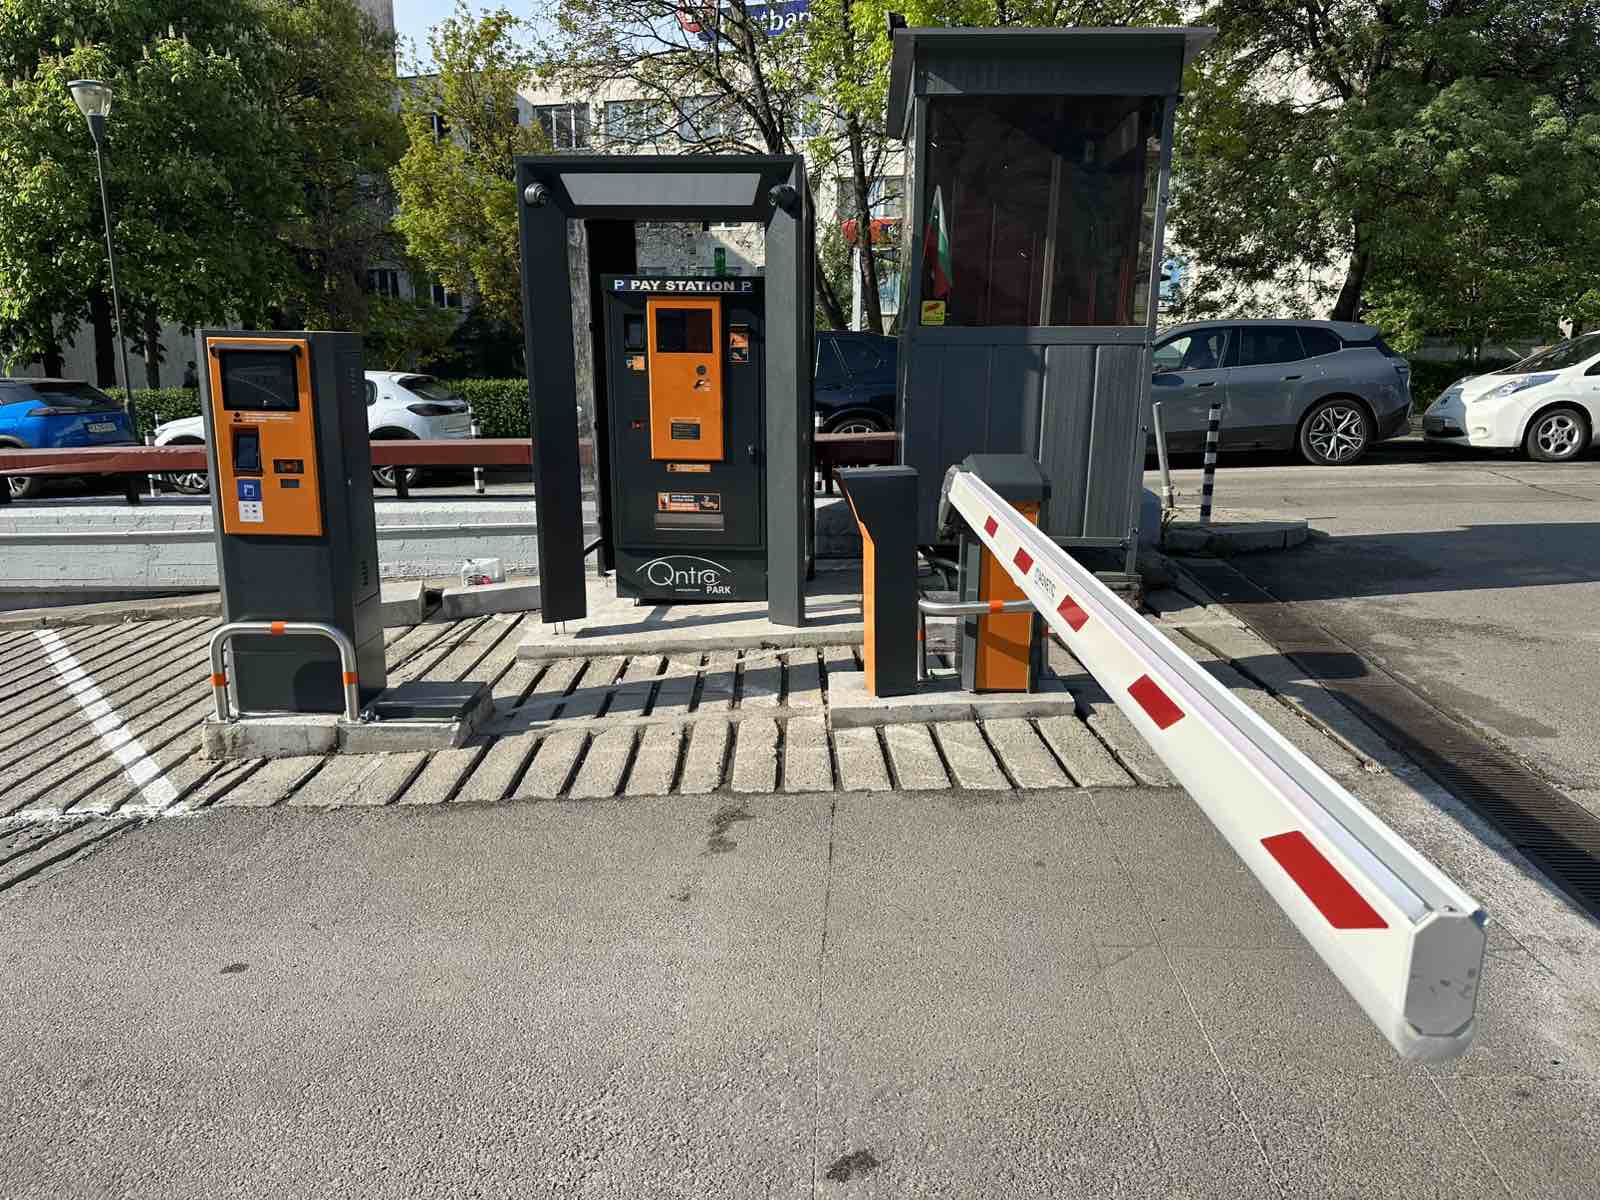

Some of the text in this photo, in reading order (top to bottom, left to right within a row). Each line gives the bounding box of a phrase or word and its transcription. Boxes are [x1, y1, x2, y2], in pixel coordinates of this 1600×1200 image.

[613, 279, 625, 290] P
[630, 280, 661, 290] PAY
[665, 280, 735, 291] STATION
[647, 561, 721, 586] Qntra
[705, 585, 732, 594] PARK
